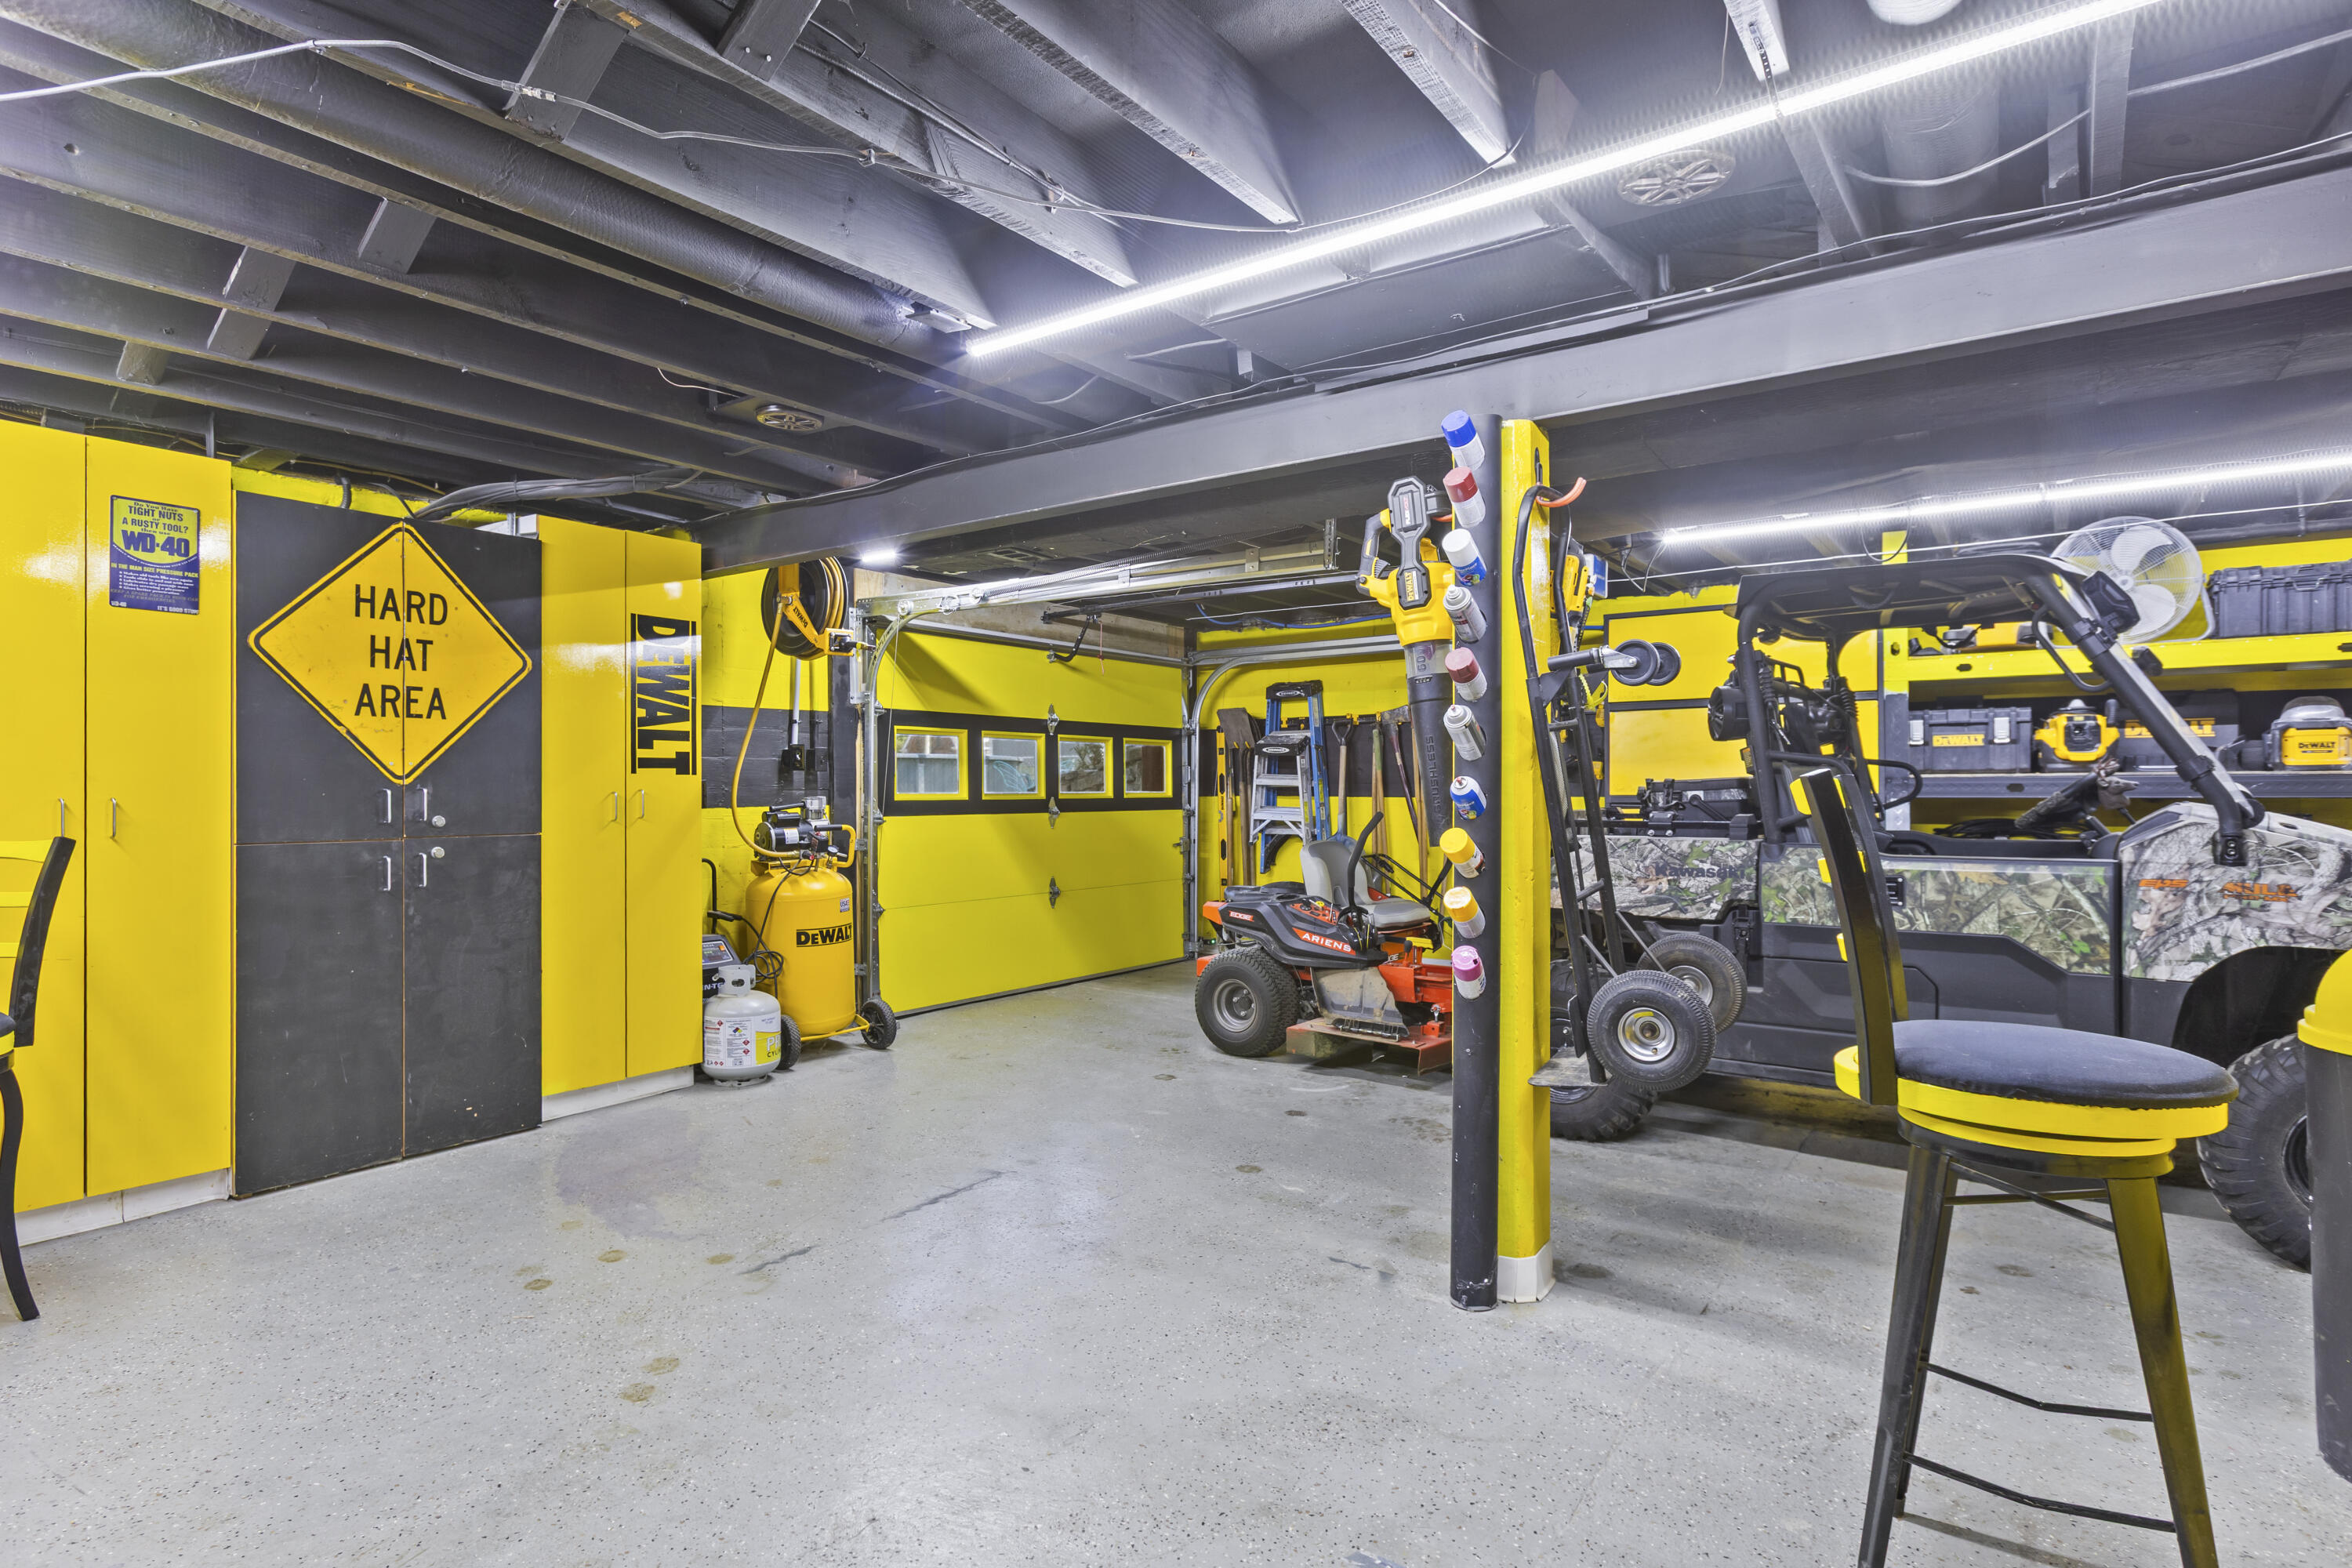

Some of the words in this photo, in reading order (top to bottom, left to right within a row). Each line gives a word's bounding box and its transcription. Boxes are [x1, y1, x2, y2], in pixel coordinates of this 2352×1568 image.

[128, 505, 155, 517] TIGHT
[158, 510, 183, 521] NUTS
[131, 518, 159, 529] RUSTY
[162, 522, 189, 533] TOOL?
[122, 529, 190, 558] WD-40
[354, 583, 448, 626] HARD
[369, 634, 434, 672] HAT
[354, 683, 447, 720] AREA
[1302, 932, 1352, 953] ARIENS
